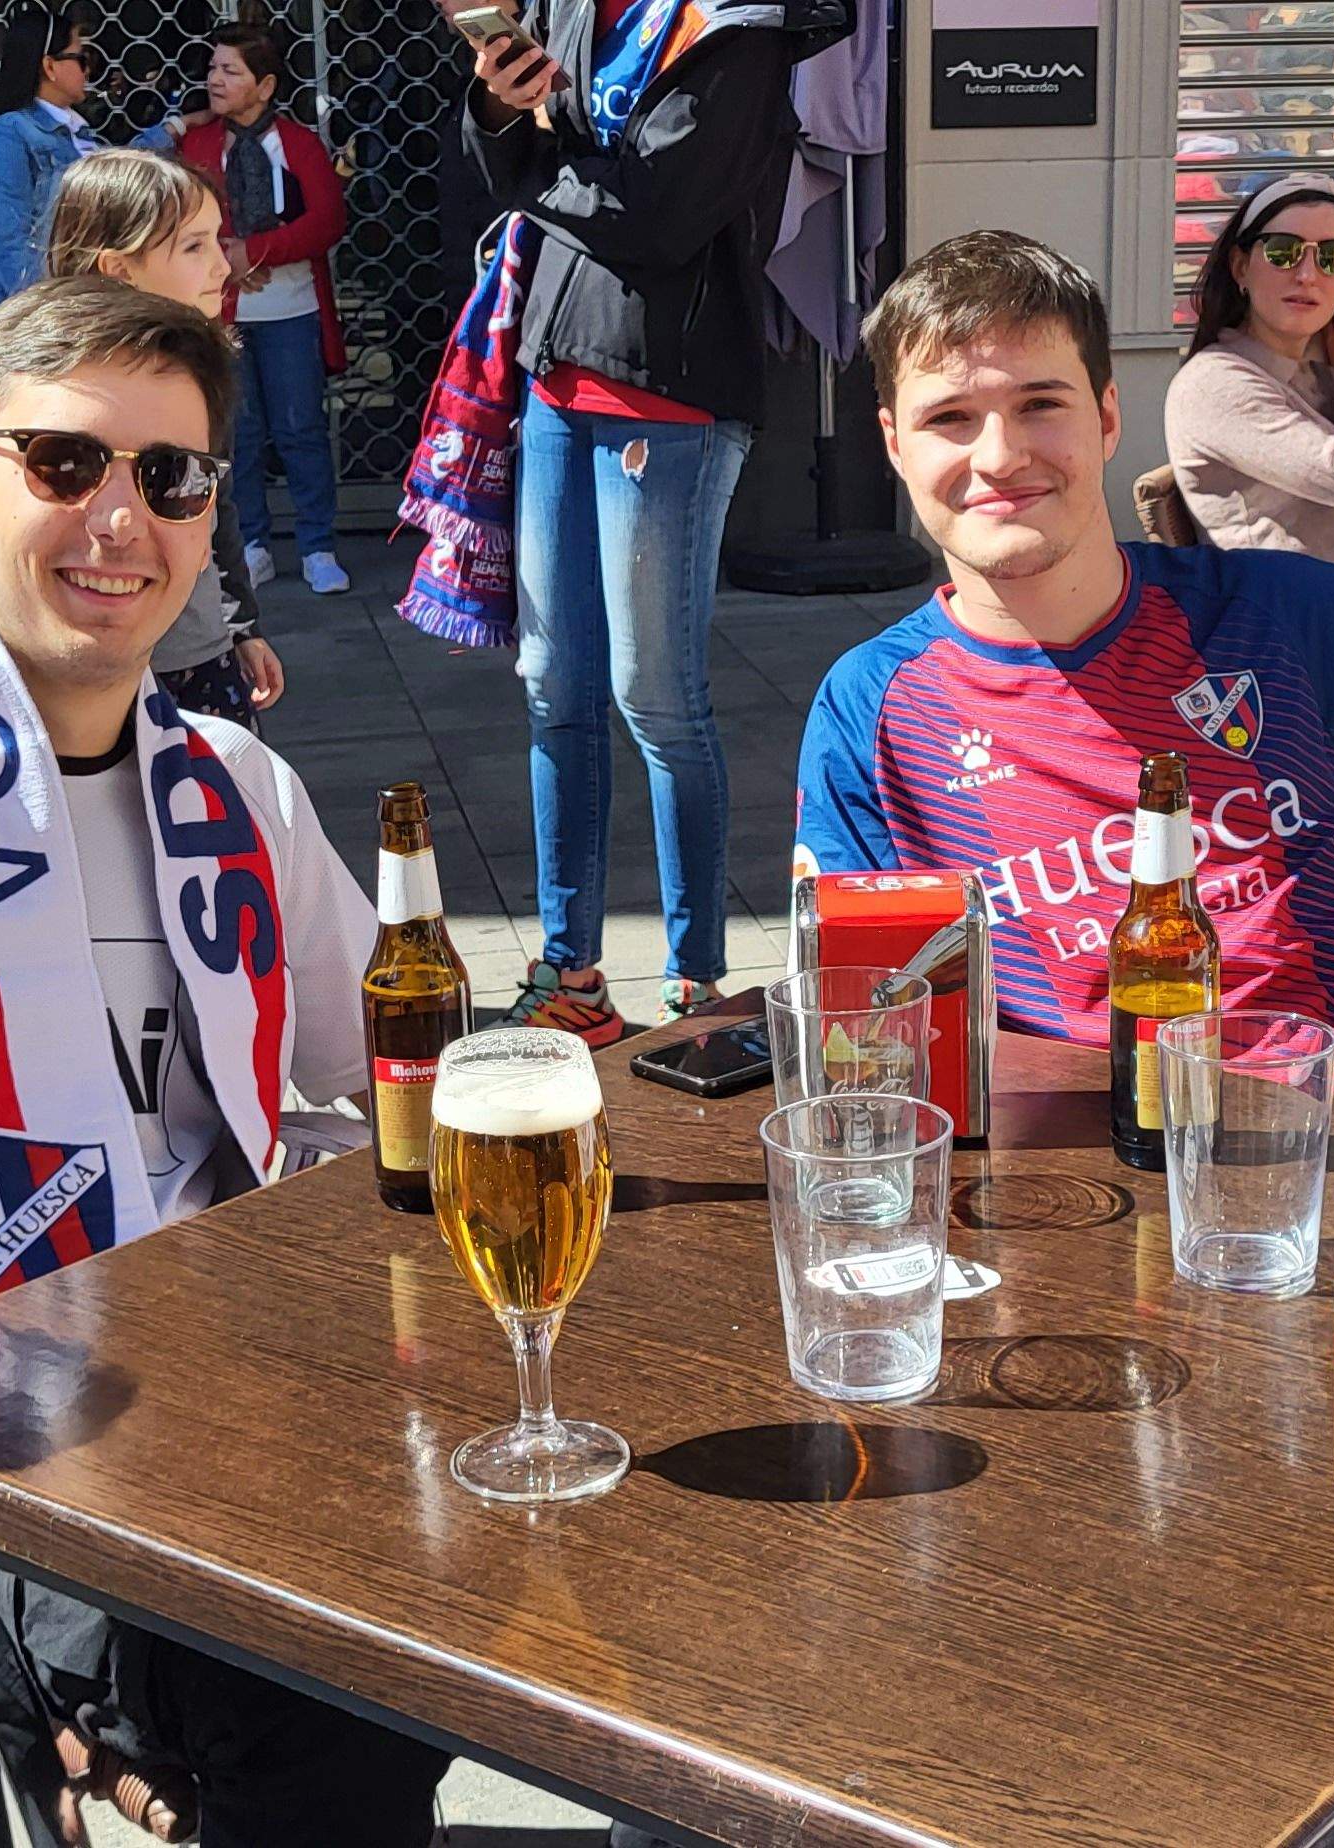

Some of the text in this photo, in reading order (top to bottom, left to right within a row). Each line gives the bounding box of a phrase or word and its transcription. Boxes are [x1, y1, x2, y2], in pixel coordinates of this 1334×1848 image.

[965, 81, 1059, 94] futuros recuerdos
[945, 764, 1018, 793] KELME
